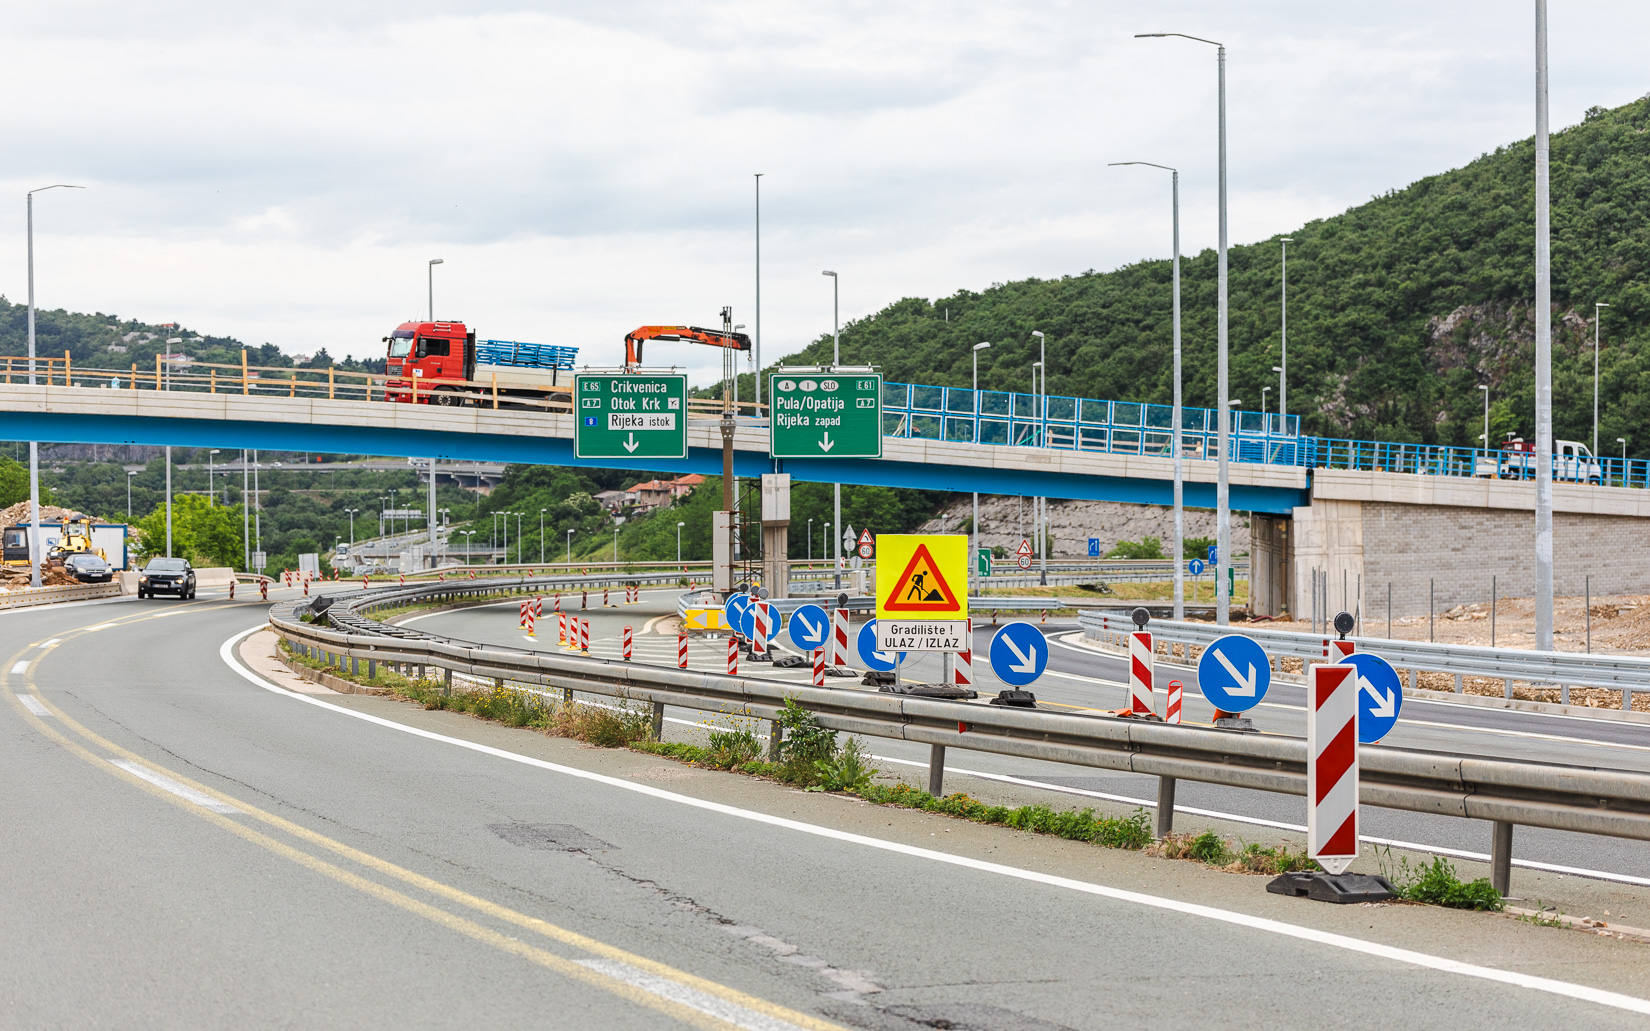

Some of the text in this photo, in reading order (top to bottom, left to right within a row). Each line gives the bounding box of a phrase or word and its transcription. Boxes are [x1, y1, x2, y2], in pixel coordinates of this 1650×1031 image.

[584, 382, 599, 390] E 65
[611, 380, 667, 393] Crikvenica
[784, 382, 789, 390] A
[823, 382, 836, 390] SLO
[857, 381, 872, 390] E 61
[611, 397, 661, 410] Otok Krk
[777, 396, 845, 413] Pula/Opatija
[611, 414, 670, 430] Rijeka istok
[777, 413, 841, 429] Rijeka zapad
[861, 547, 870, 555] 60
[1020, 557, 1029, 566] 60
[891, 624, 946, 635] Gradilište
[885, 637, 959, 649] ULAZ / IZLAZ
